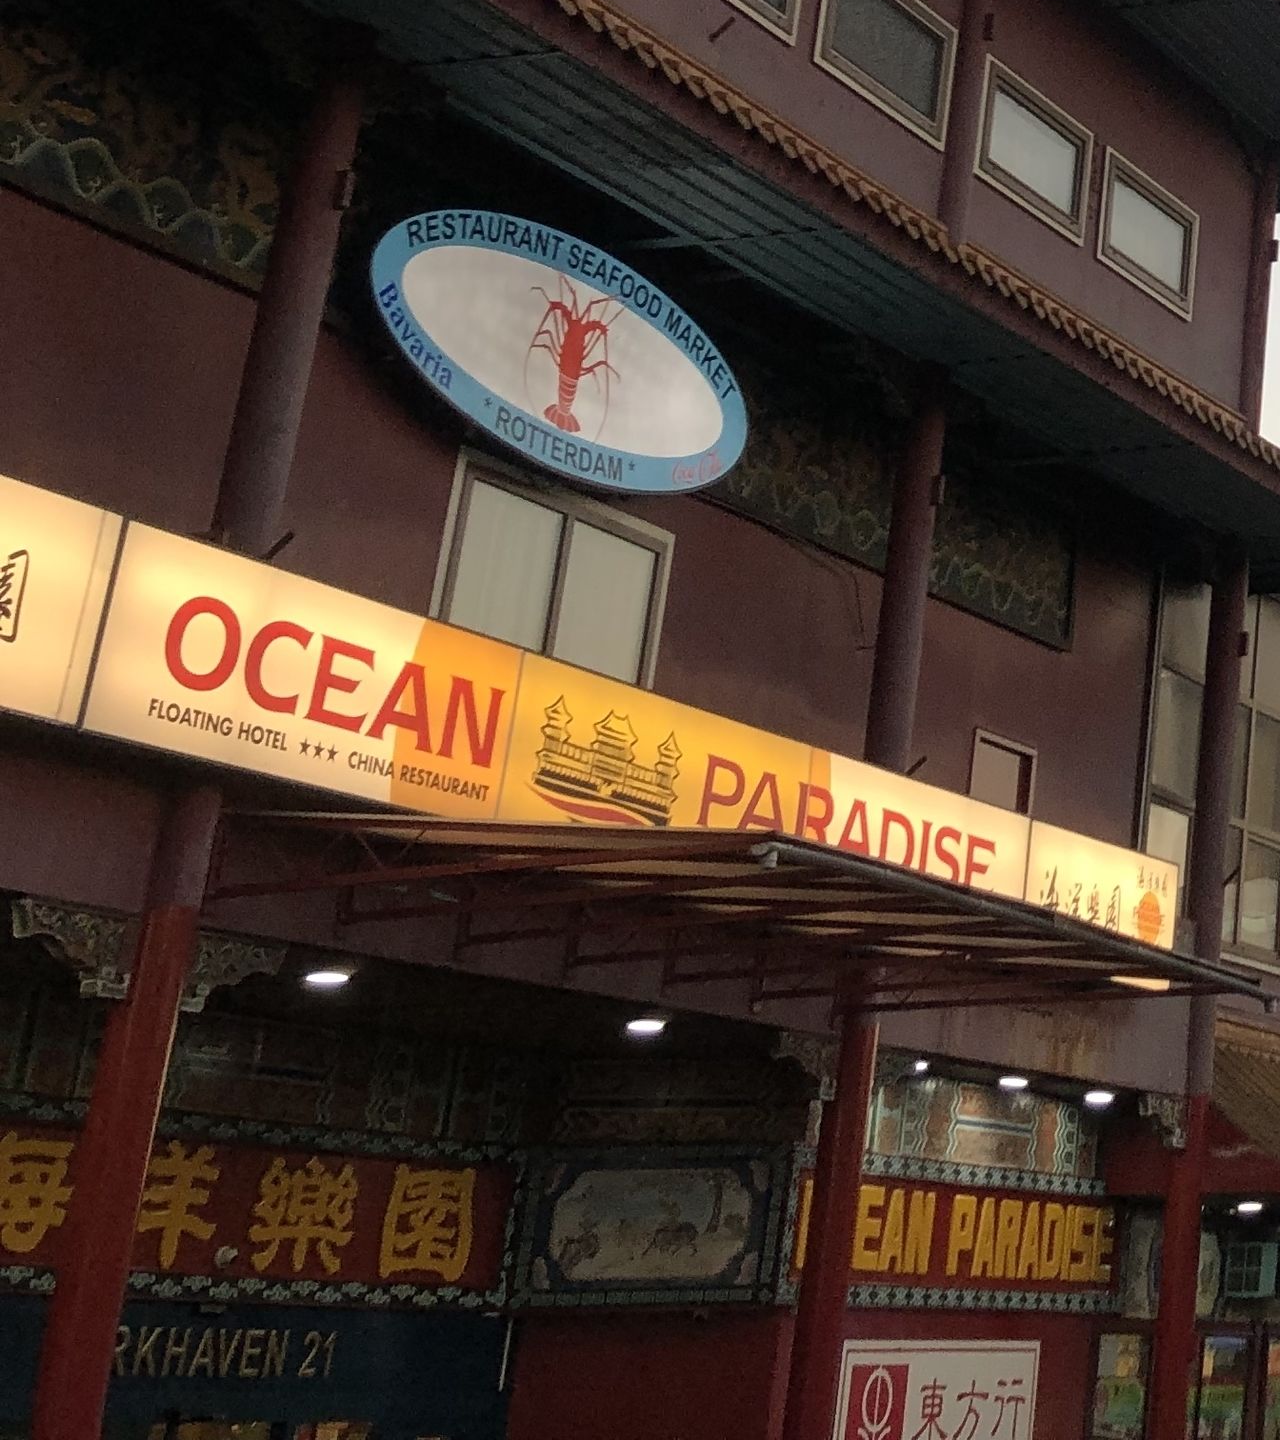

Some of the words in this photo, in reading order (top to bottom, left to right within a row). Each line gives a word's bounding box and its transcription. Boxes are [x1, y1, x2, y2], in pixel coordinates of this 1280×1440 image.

[378, 281, 453, 391] Bavaria
[406, 212, 564, 260] RESTAURANT
[568, 244, 662, 319] SEAFOOD
[663, 304, 740, 400] MARKET
[495, 406, 624, 482] ROTTERDAM
[165, 595, 507, 770] OCEAN
[148, 697, 233, 739] FLOATING
[237, 721, 288, 752] HOTEL
[347, 749, 395, 779] CHINA
[399, 764, 489, 802] RESTAURANT
[697, 753, 998, 888] PARADISE
[946, 1195, 1115, 1283] PARADISE
[111, 1325, 290, 1379] RKHAVEN
[297, 1329, 338, 1378] 21
